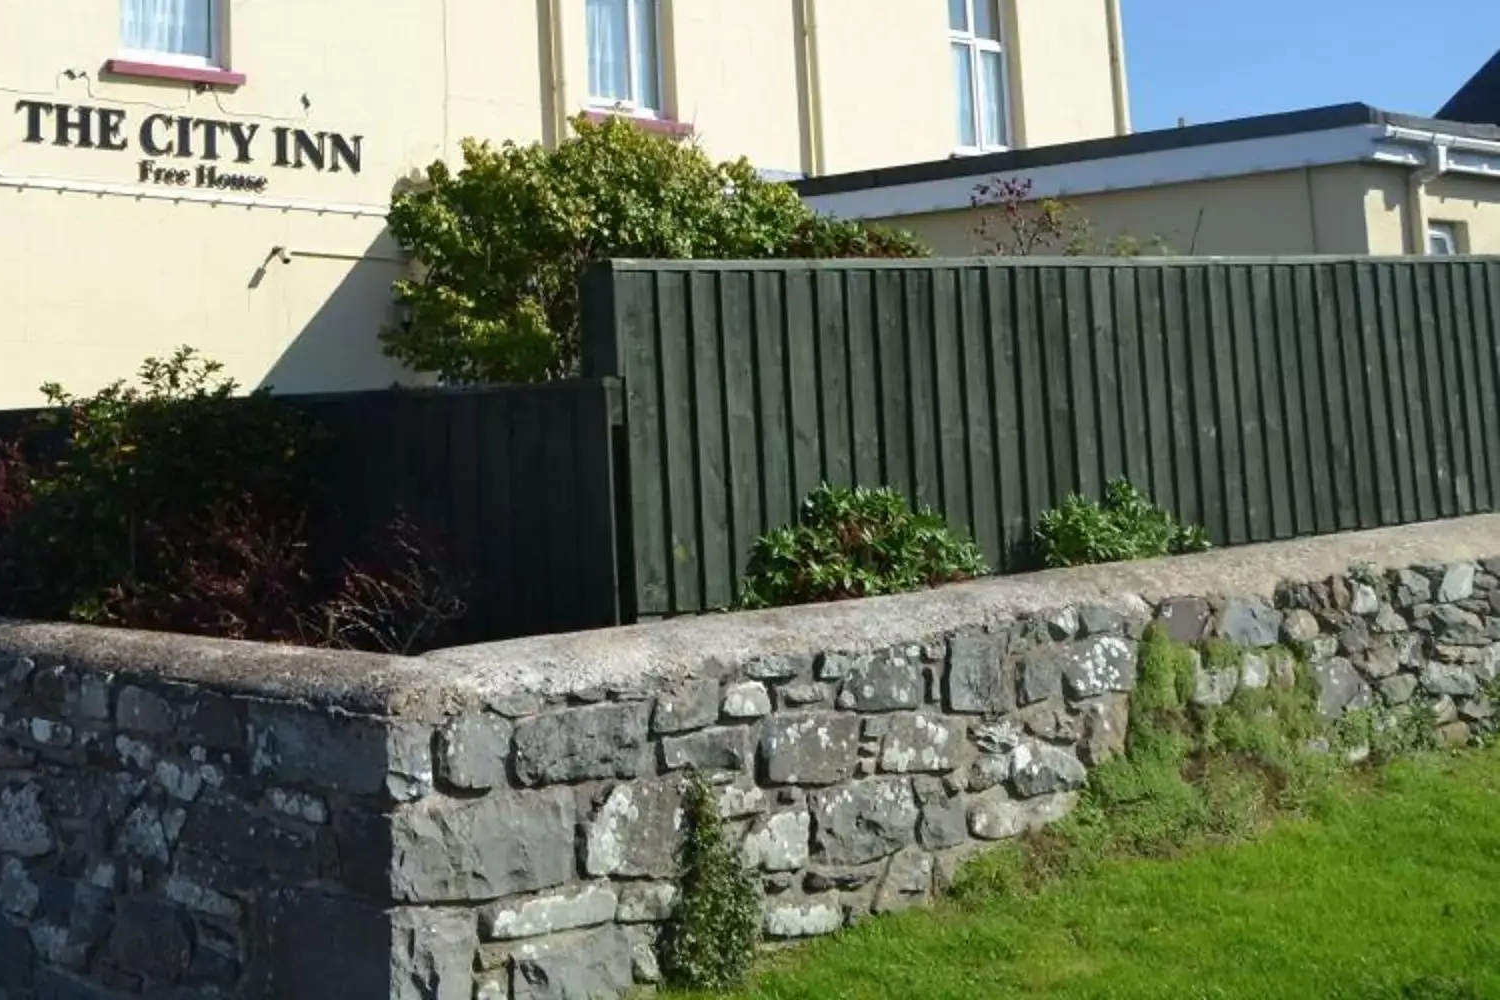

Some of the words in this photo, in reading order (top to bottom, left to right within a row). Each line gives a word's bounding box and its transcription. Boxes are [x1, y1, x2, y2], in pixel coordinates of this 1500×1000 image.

[15, 99, 128, 151] THE
[138, 113, 260, 164] CITY
[271, 126, 364, 175] INN
[137, 159, 190, 185] Free
[195, 165, 268, 194] House
